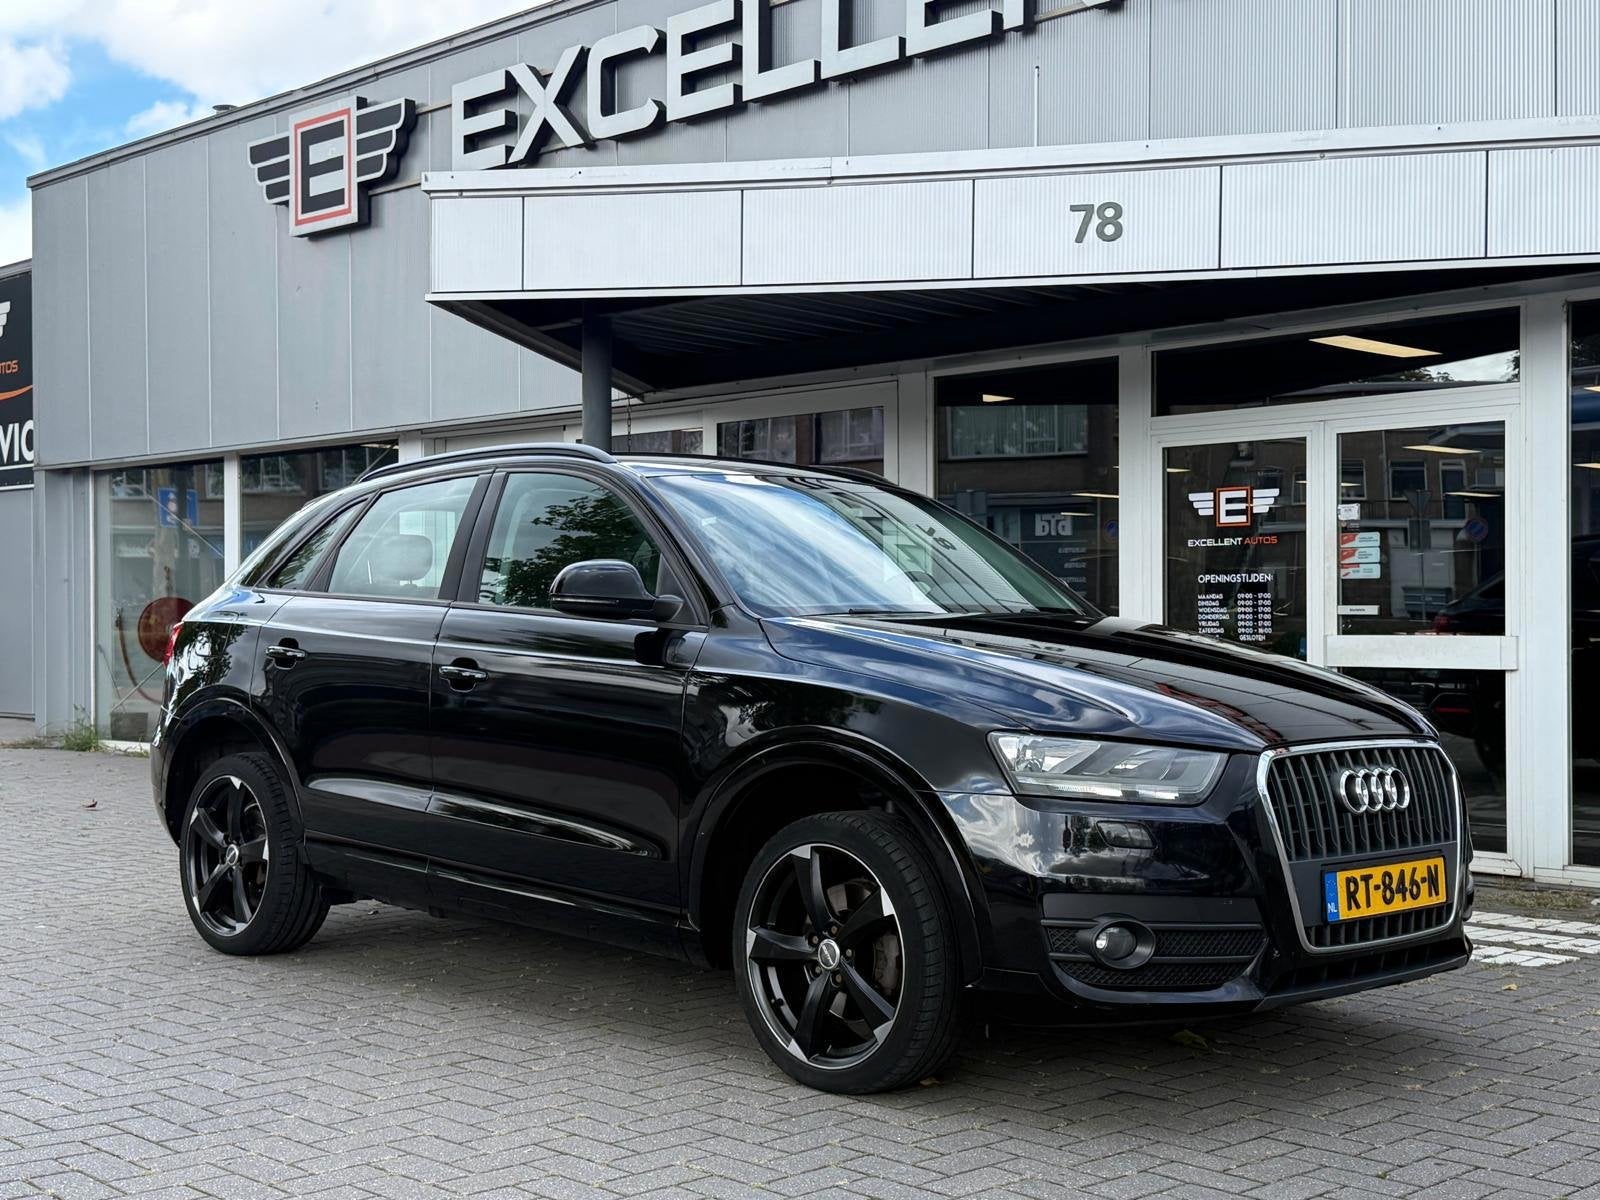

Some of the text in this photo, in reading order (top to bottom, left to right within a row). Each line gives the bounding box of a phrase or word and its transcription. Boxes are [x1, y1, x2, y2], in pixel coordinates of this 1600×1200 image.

[1069, 201, 1123, 244] 78
[1187, 536, 1278, 547] EXCELLENT AUTOS
[1344, 863, 1440, 911] RT-846-N
[1327, 902, 1338, 913] NL
